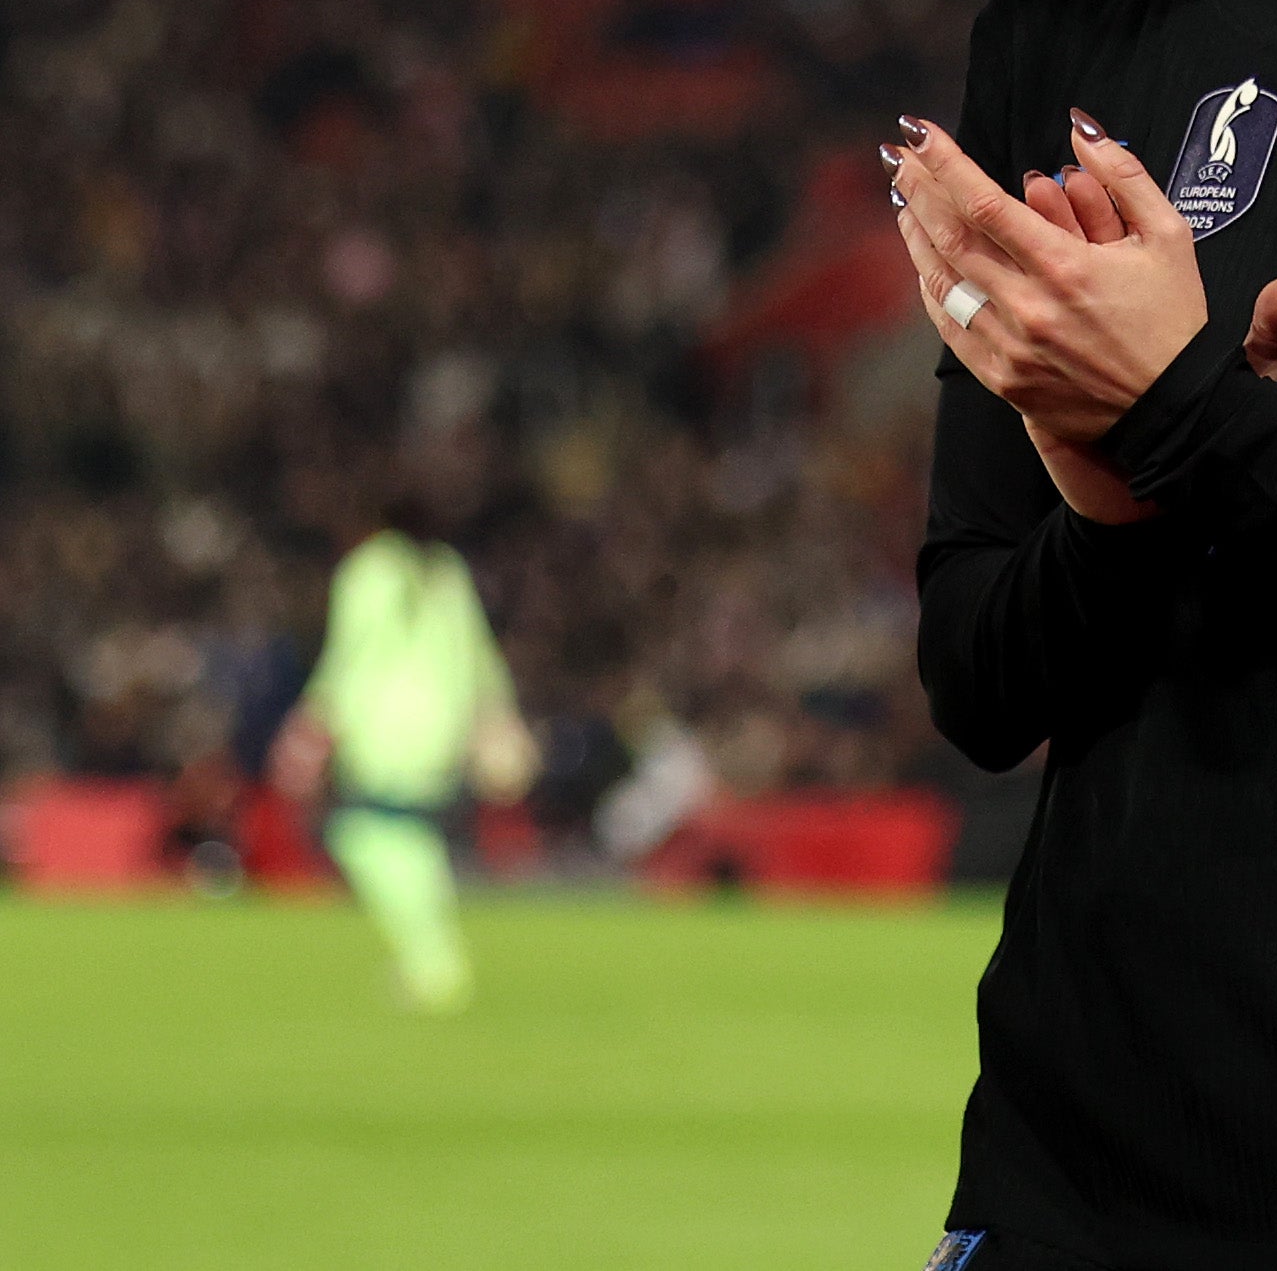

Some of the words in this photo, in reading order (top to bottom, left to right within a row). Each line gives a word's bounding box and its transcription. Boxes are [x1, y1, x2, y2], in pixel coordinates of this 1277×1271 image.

[1198, 165, 1229, 181] UEFA
[1180, 186, 1236, 198] EUROPEAN
[1174, 199, 1234, 213] CHAMPIONS
